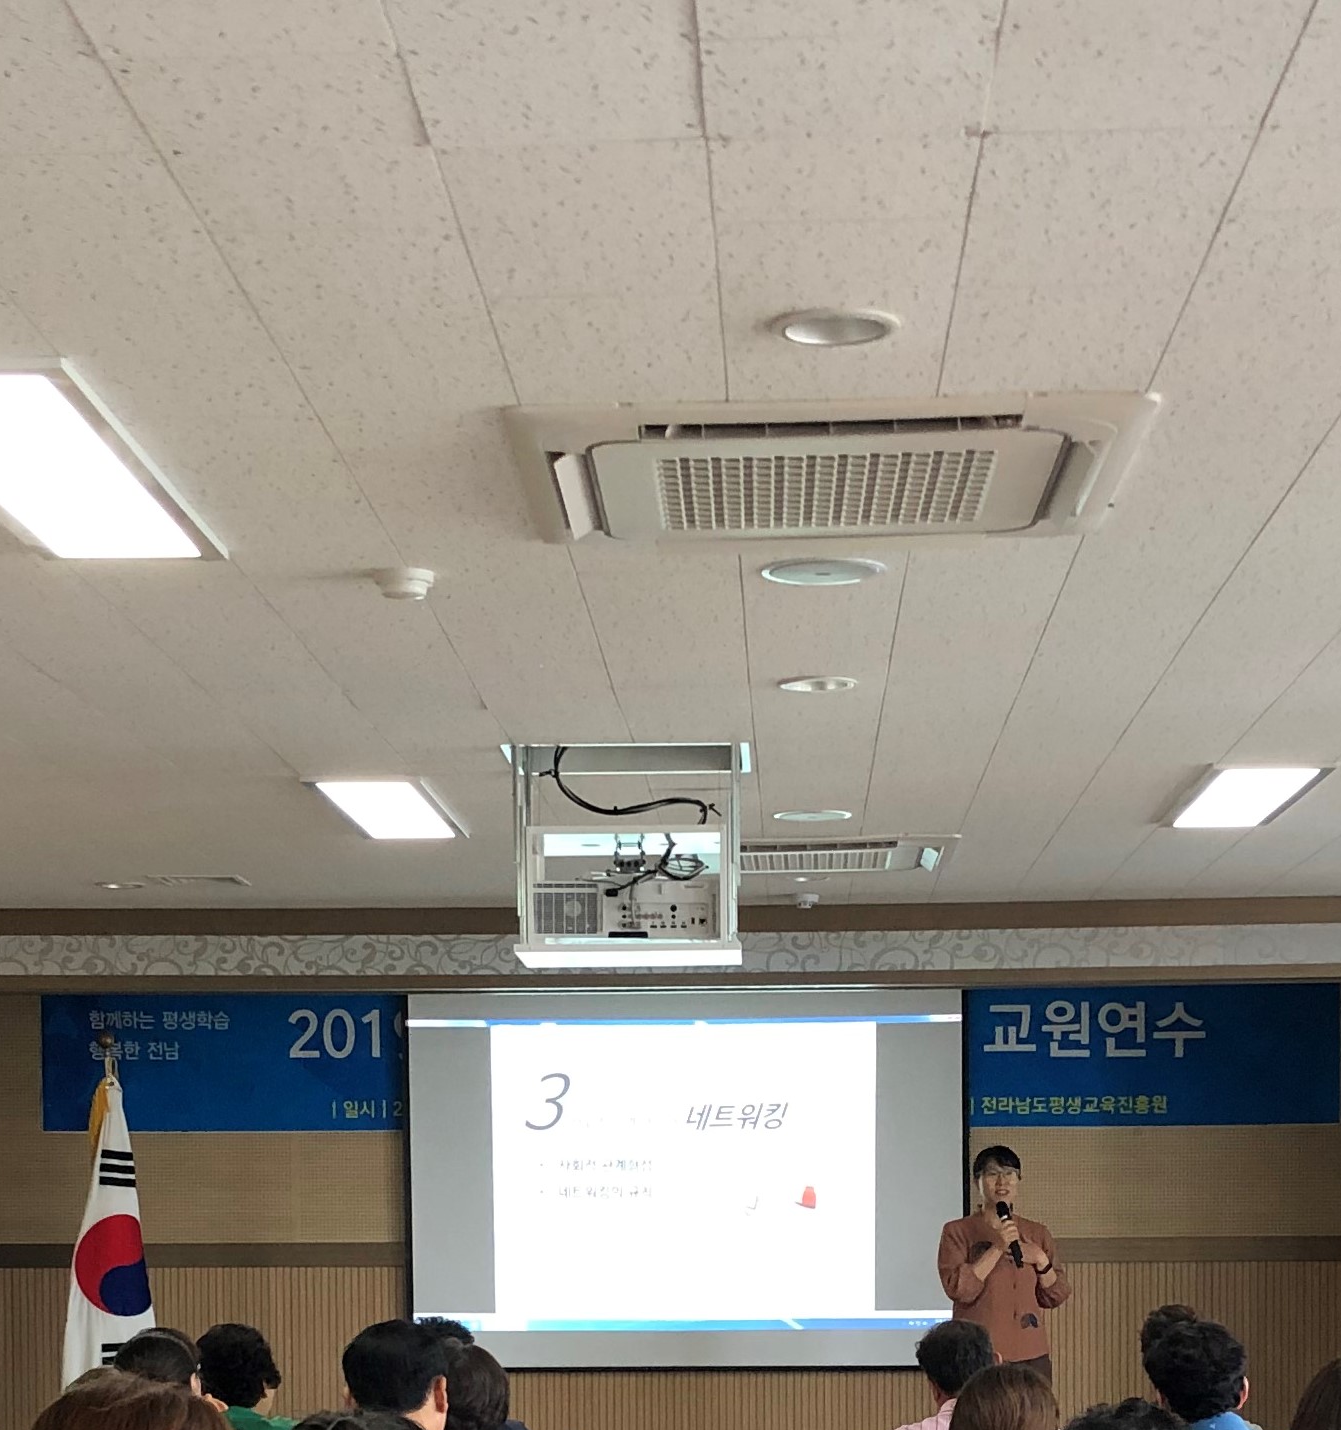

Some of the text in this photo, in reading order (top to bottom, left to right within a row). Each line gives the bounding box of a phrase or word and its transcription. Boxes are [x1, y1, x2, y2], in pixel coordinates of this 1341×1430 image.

[89, 1010, 230, 1031] 함께하는 평생학습
[983, 1000, 1207, 1058] 교원연수
[147, 1041, 180, 1061] 전남
[343, 1100, 376, 1119] 일시
[525, 1072, 789, 1131] 3 네트워킹
[981, 1095, 1168, 1116] 전라남도평생교육진흥원
